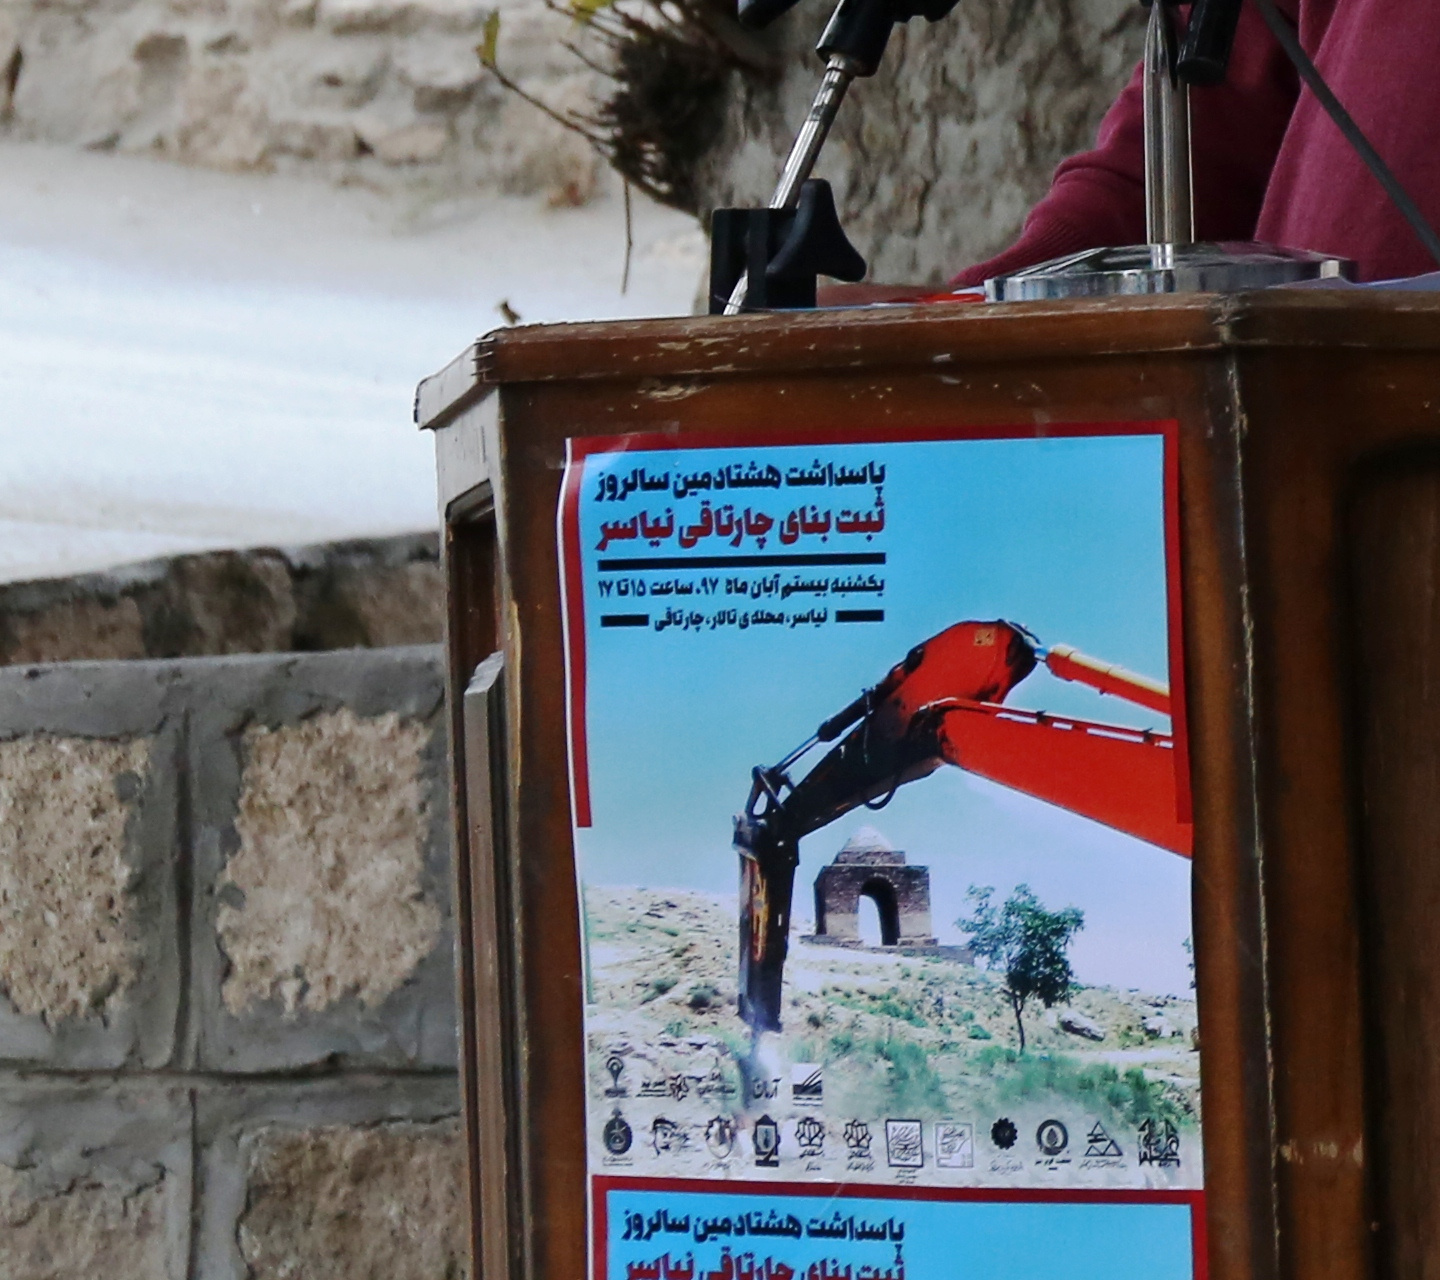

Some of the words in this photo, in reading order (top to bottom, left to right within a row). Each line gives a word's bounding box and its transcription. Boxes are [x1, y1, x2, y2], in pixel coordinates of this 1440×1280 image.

[594, 465, 670, 501] سالروز
[672, 460, 782, 499] هشتادمین
[785, 459, 886, 495] پاسداشت
[595, 507, 675, 551] نیاسر
[678, 500, 775, 550] چارتاقی
[779, 504, 831, 544] بنای
[835, 495, 886, 542] ثبت
[616, 577, 630, 597] تا
[650, 578, 694, 596] ساعت
[725, 576, 748, 595] ماه
[751, 573, 780, 599] آبان
[780, 576, 829, 601] بیستم
[830, 575, 885, 599] یکشنبه
[654, 607, 705, 632] چارتاقی
[620, 1208, 690, 1242] سالروز
[693, 1208, 803, 1243] هشتادمین
[805, 1209, 905, 1252] پاسداشت
